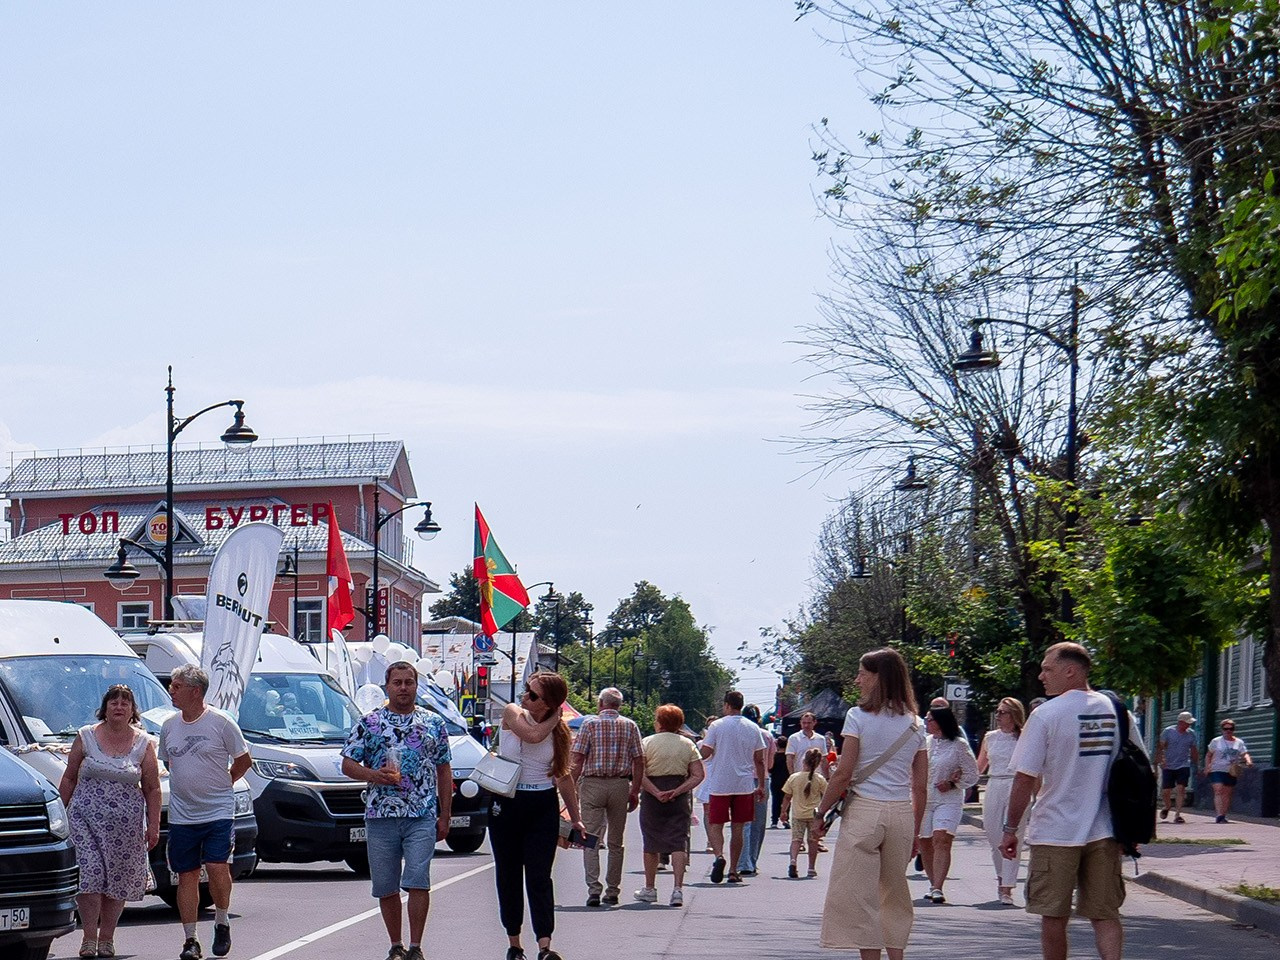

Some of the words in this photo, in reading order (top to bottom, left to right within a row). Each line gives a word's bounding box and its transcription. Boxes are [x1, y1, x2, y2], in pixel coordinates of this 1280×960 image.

[58, 511, 119, 535] ТОП
[205, 502, 330, 531] БУРГЕР
[1079, 722, 1100, 731] FILA
[12, 909, 26, 923] 50
